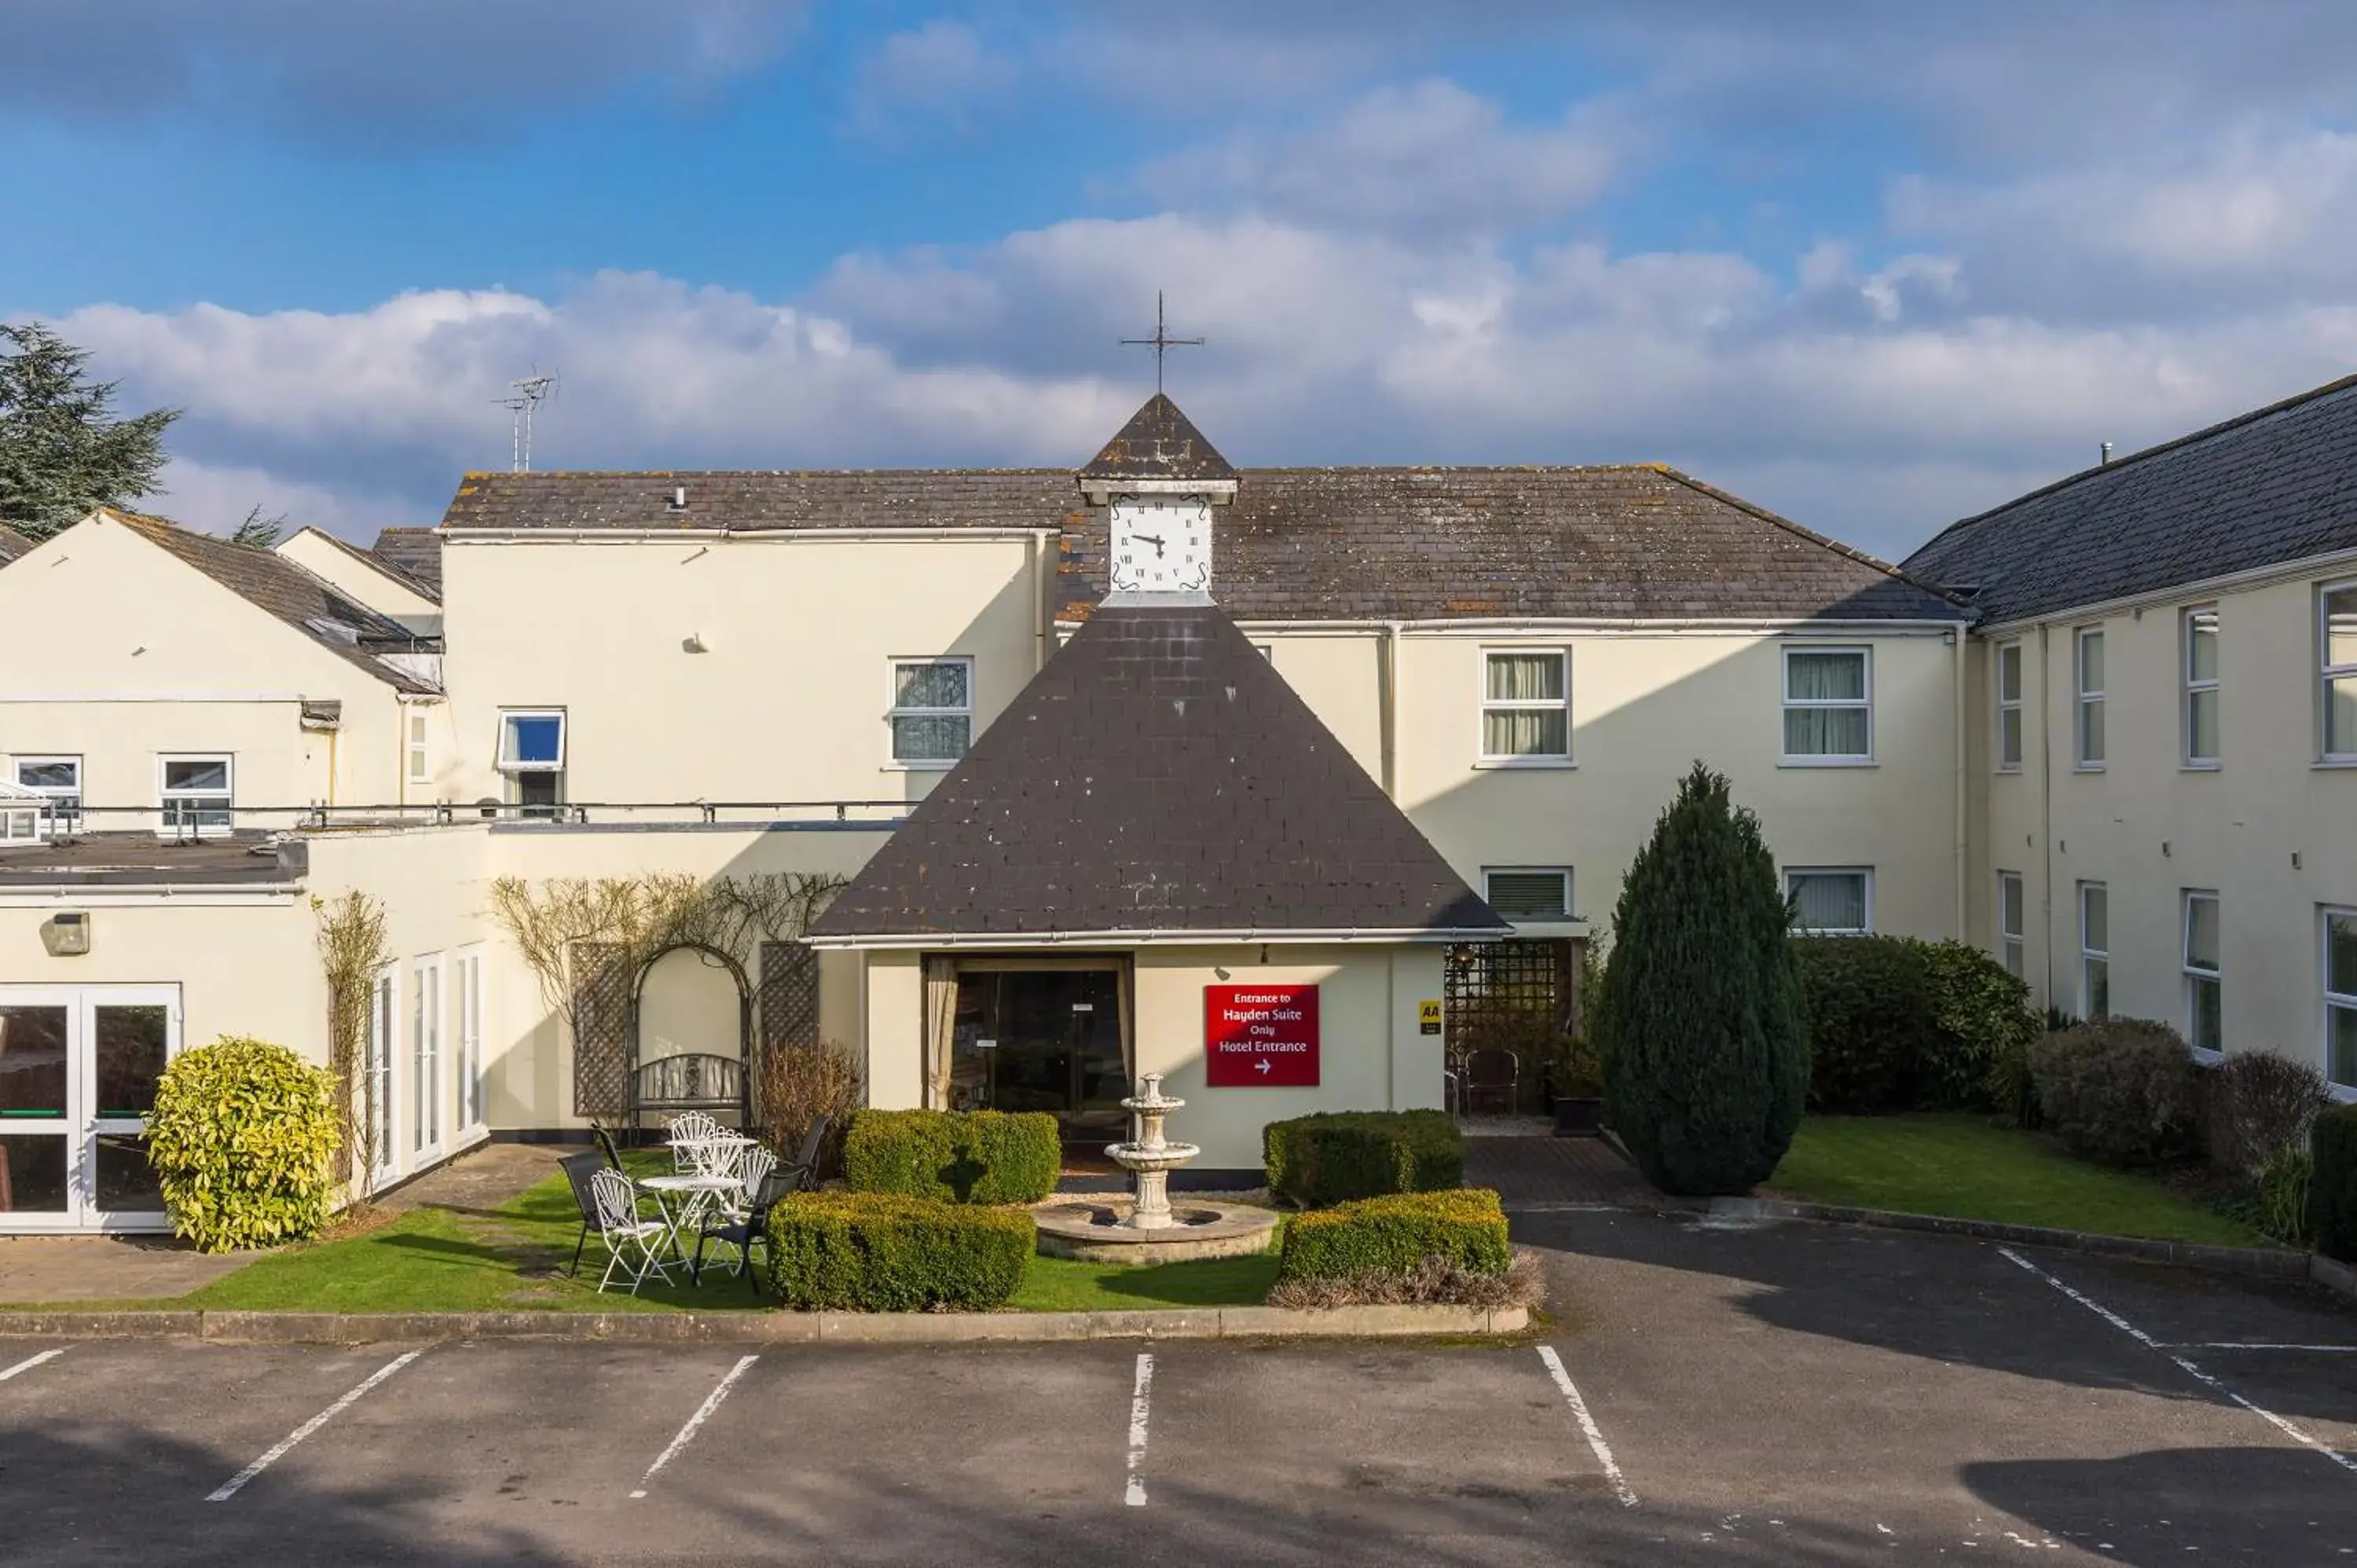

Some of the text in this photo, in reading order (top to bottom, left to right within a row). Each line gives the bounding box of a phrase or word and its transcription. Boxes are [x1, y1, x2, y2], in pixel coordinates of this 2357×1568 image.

[1234, 994, 1291, 1003] Entrance to
[1223, 1009, 1302, 1023] Hayden Suite
[1423, 1006, 1439, 1017] AA
[1250, 1025, 1275, 1037] Only
[1219, 1041, 1307, 1052] Hotel Entrance
